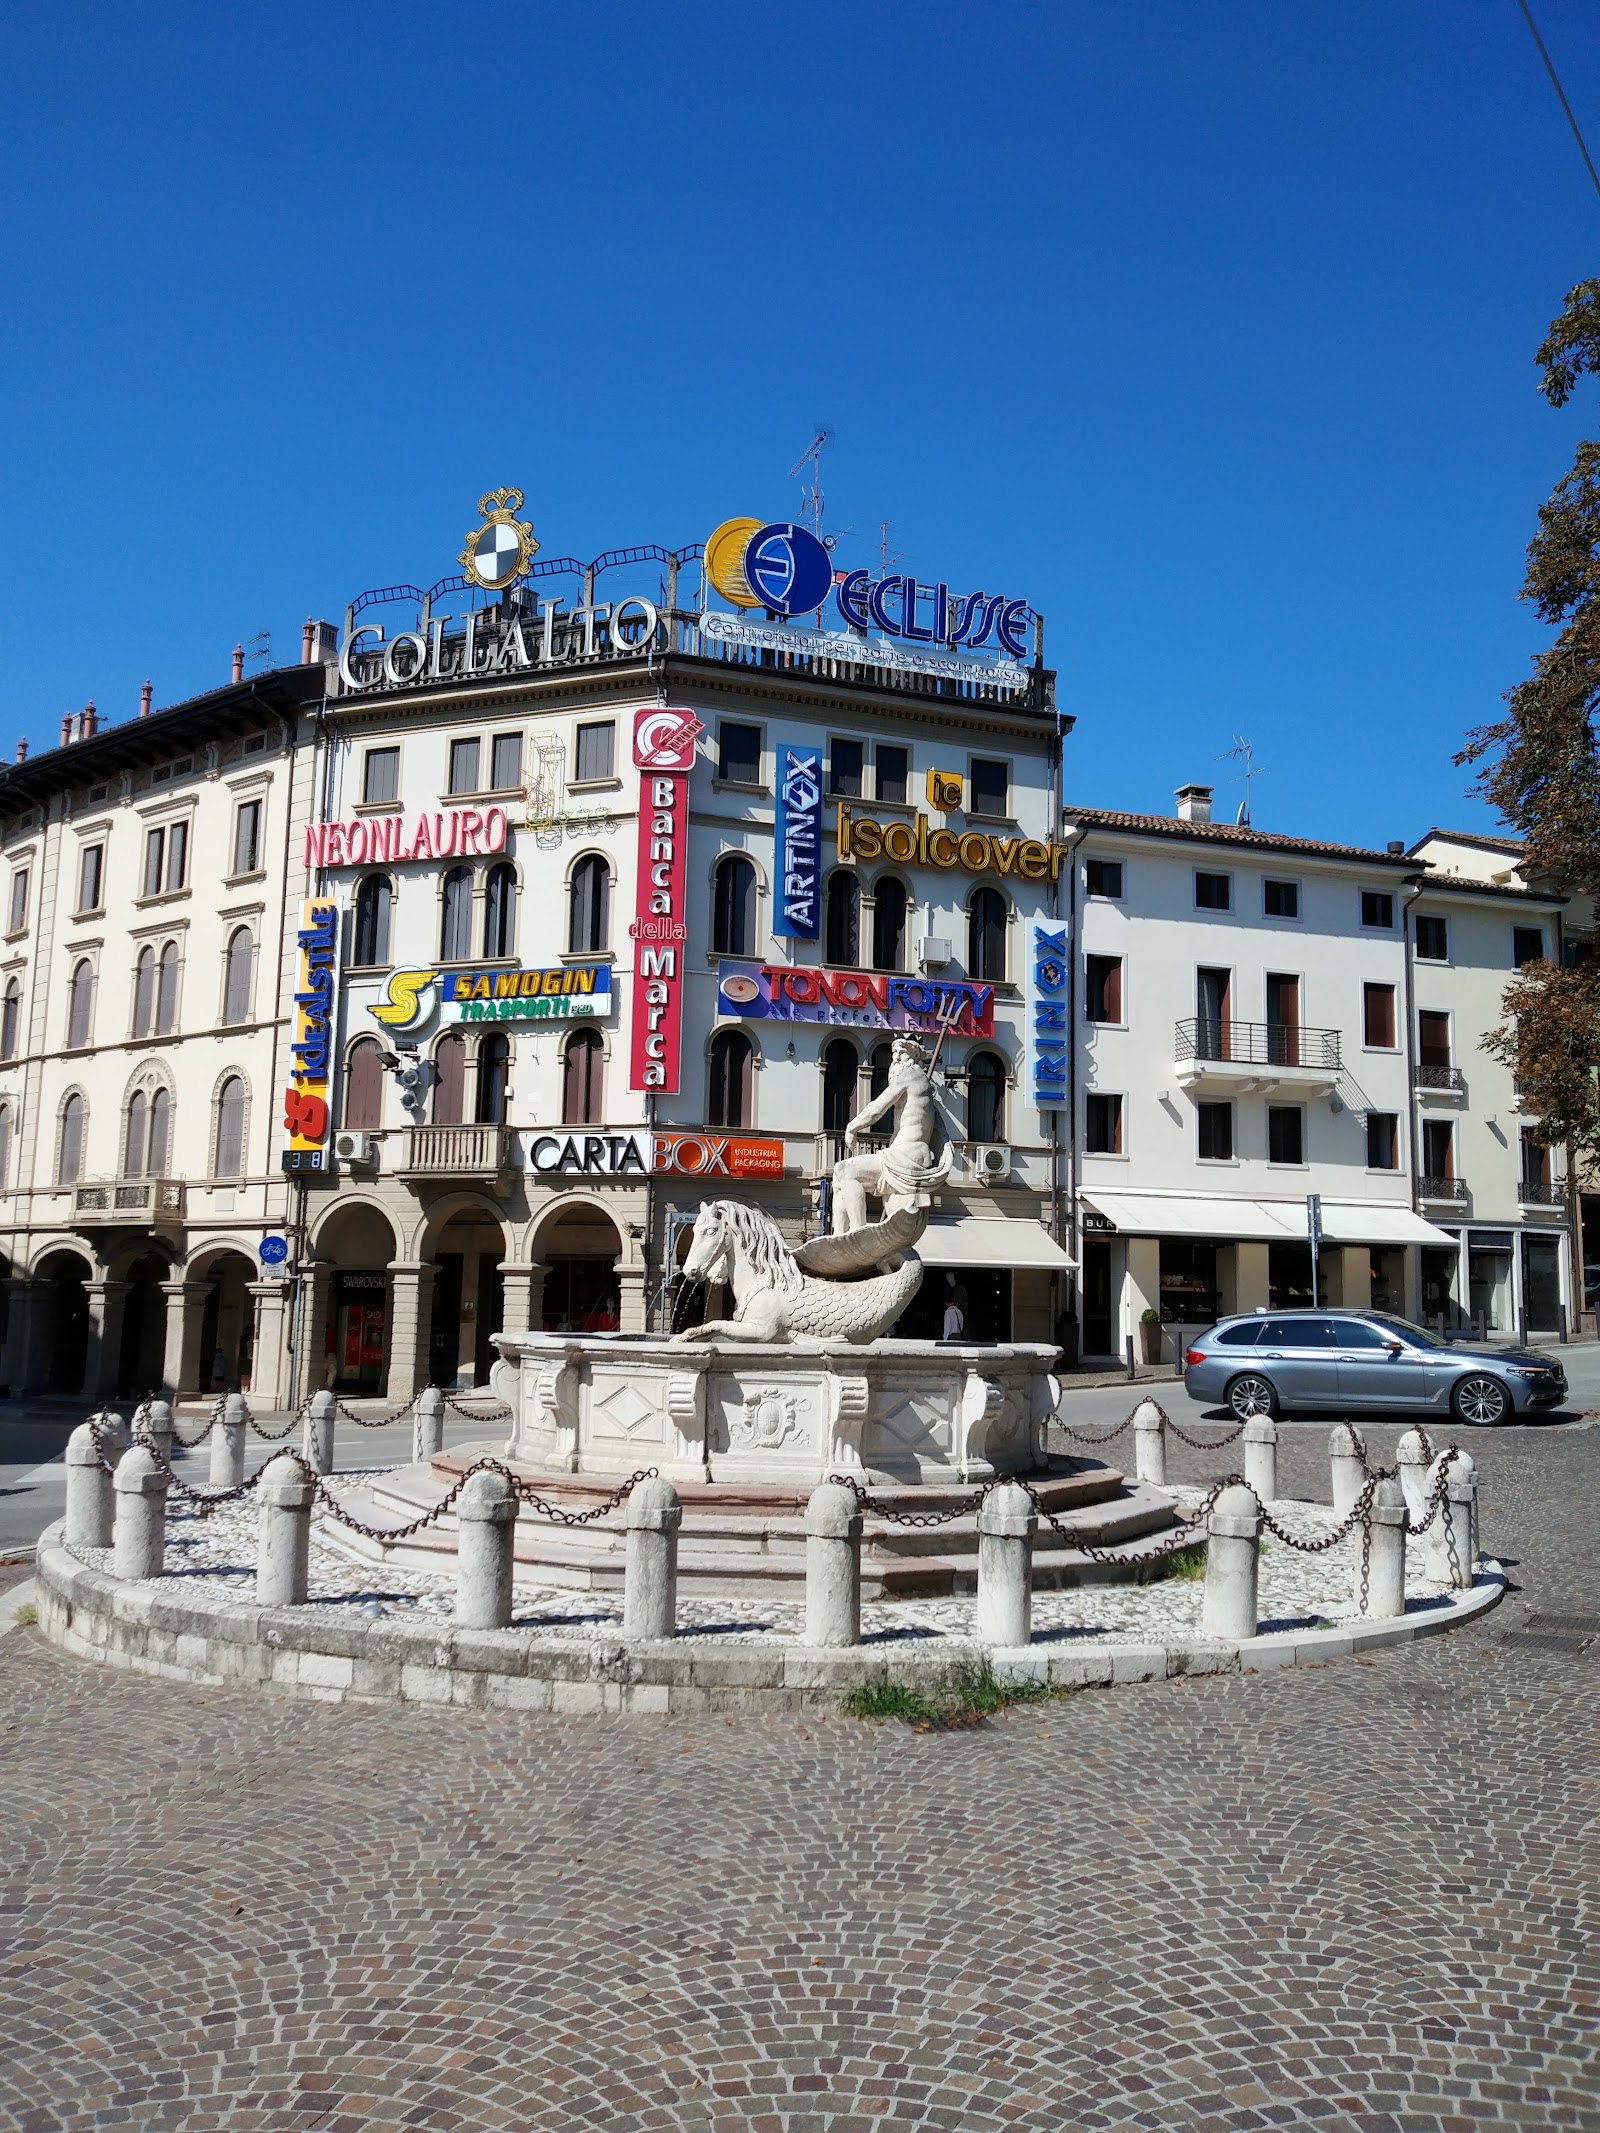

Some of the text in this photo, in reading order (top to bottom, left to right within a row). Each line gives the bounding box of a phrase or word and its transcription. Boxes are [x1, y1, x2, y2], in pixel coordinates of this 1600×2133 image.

[339, 596, 657, 689] COLLALTO
[837, 569, 1028, 659] ECLISSE
[708, 616, 816, 647] Controtelai
[823, 640, 854, 654] per
[859, 646, 907, 663] porte
[929, 657, 1023, 682] scomparsa
[303, 806, 507, 867] NEONLAURO
[649, 777, 675, 914] Banca
[782, 751, 819, 928] ARTINOX
[838, 802, 1068, 882] isolcover
[628, 917, 686, 940] della
[453, 967, 598, 1001] SAMOGIN
[459, 997, 571, 1020] TRASPORTI
[1033, 926, 1066, 1100] IRINOX
[640, 946, 674, 1086] Marca
[817, 1009, 892, 1024] perfect
[734, 1148, 778, 1158] INDUSTRIAL
[734, 1158, 781, 1169] PACKAGING
[343, 1275, 386, 1288] SWAROVSKI
